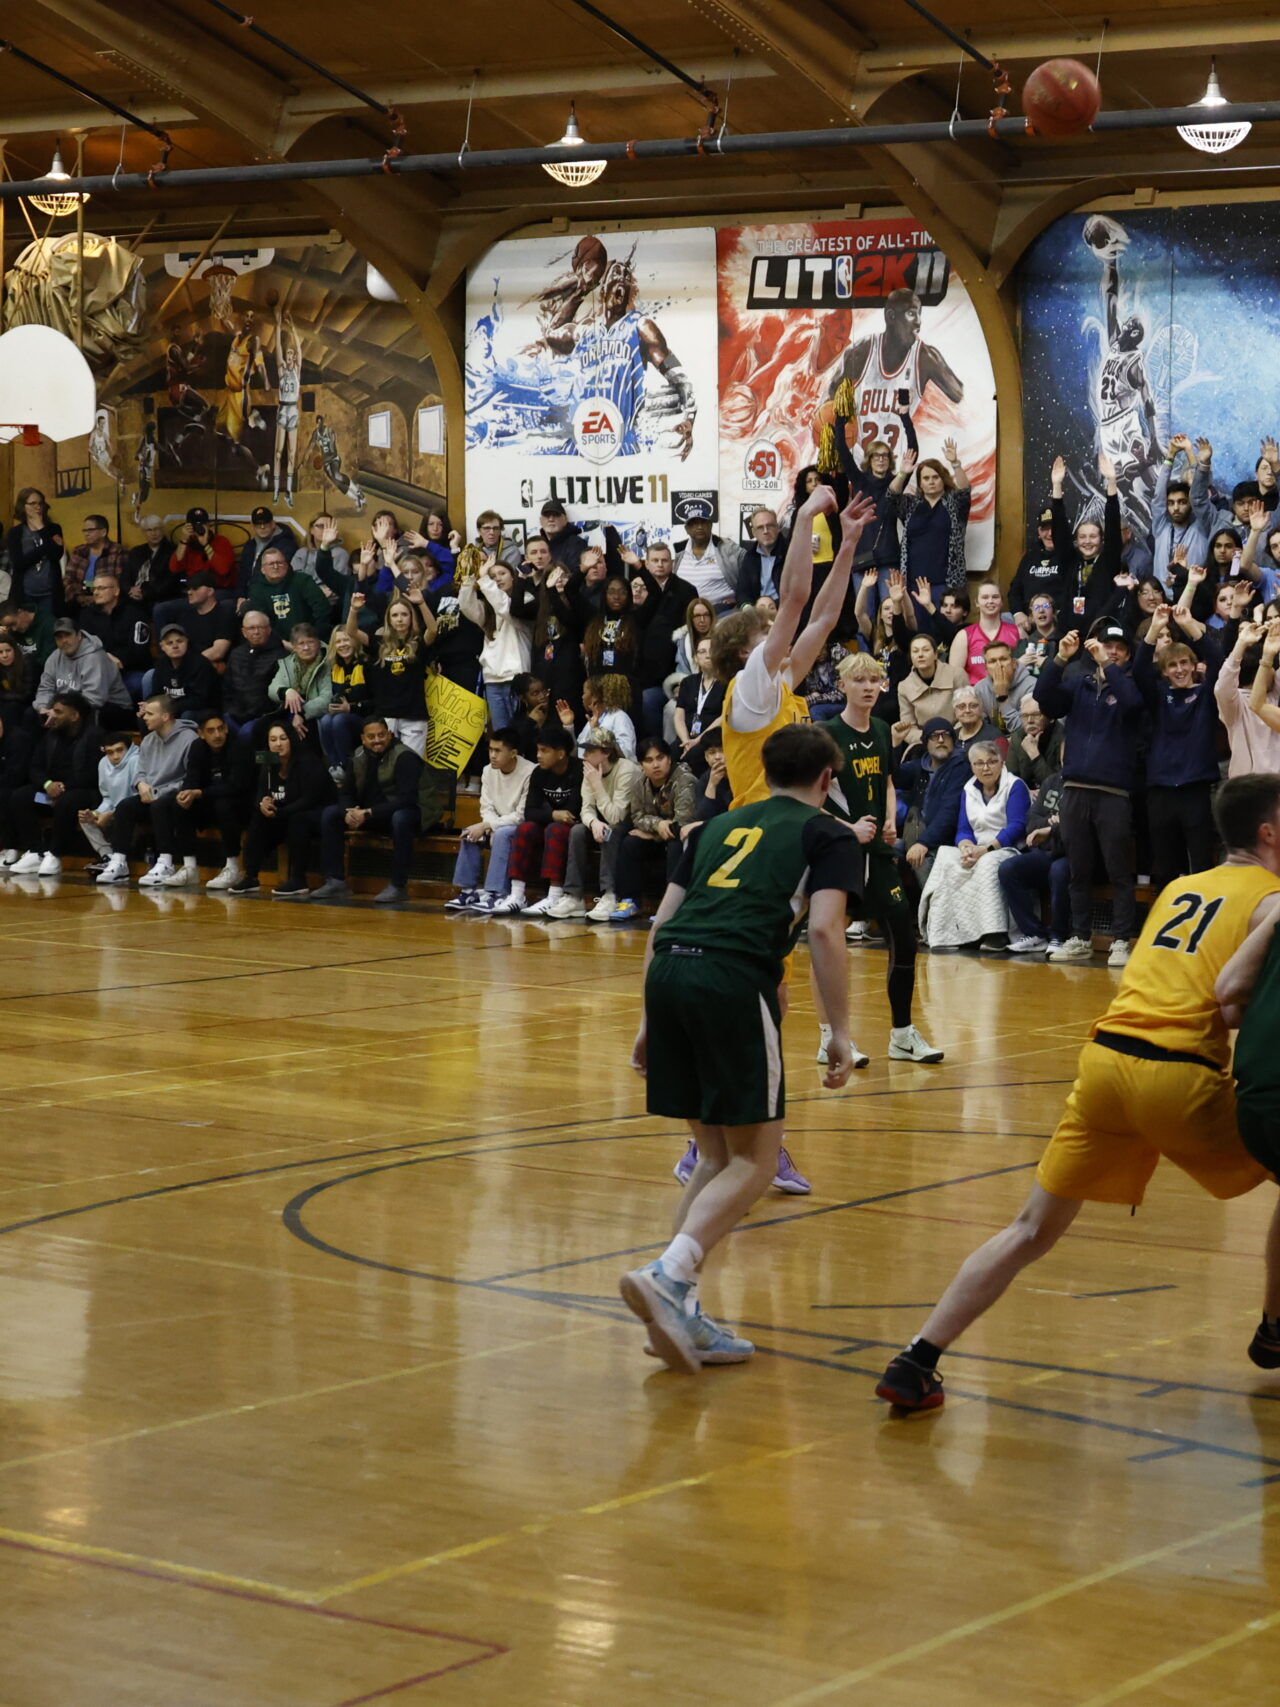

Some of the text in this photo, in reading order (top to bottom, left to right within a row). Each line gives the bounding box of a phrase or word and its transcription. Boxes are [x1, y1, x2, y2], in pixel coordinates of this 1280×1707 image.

[757, 230, 936, 254] THE GREATEST OF ALL-TIM
[752, 257, 833, 300] LIT
[860, 387, 903, 416] BULL
[581, 411, 615, 434] EA
[861, 421, 900, 452] 23
[580, 433, 616, 446] SPORTS
[550, 474, 669, 505] LIT LIVE 11
[707, 826, 764, 889] 2
[1151, 892, 1227, 956] 21
